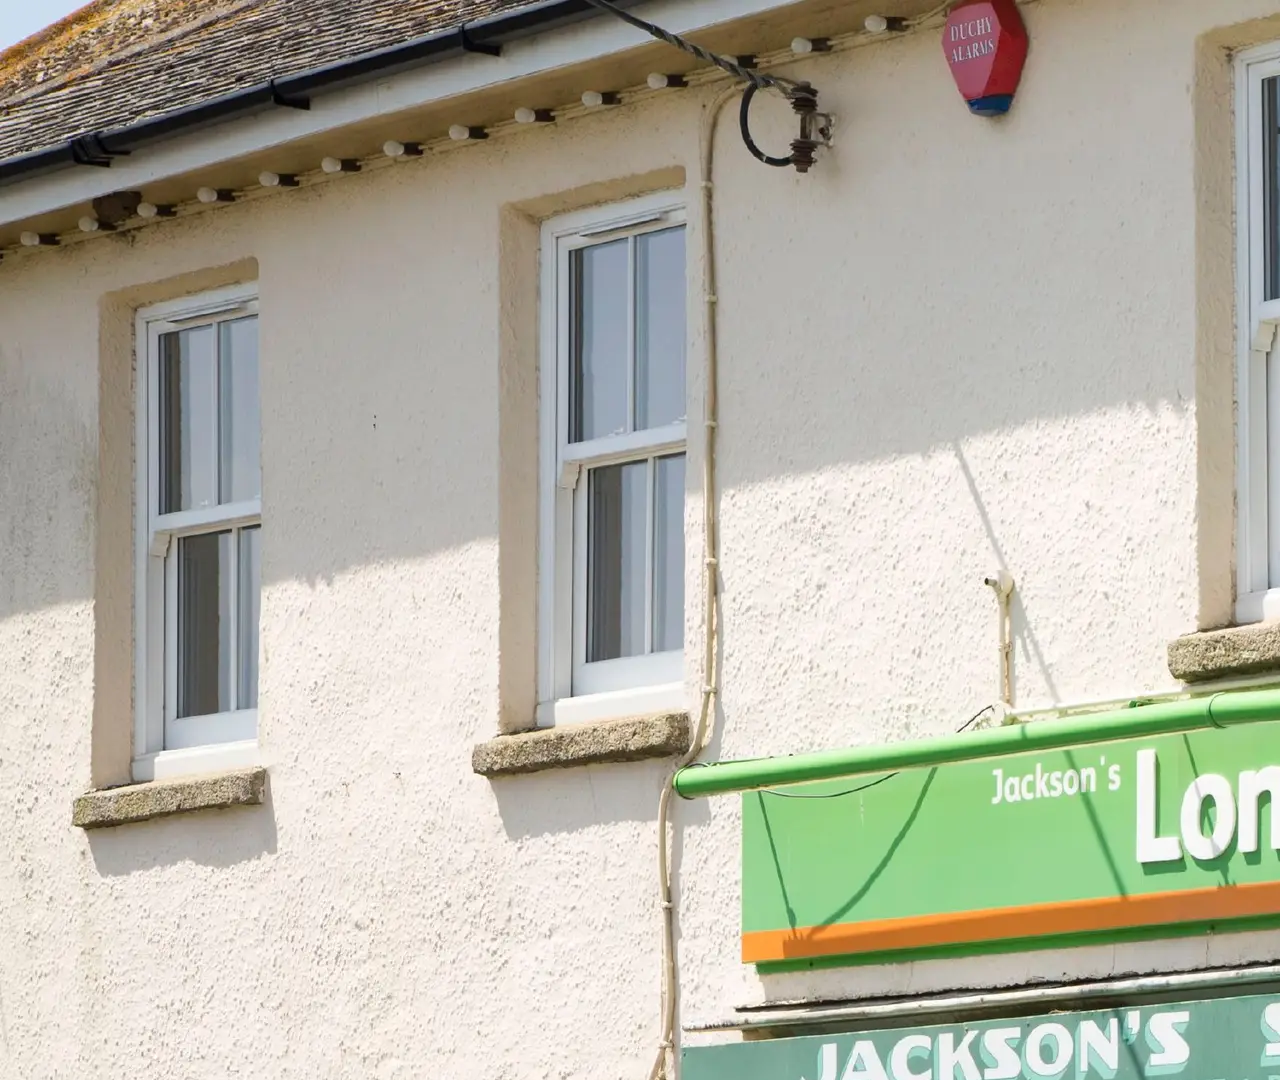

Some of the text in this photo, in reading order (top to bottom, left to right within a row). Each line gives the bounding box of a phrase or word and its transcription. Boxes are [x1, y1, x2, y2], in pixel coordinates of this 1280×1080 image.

[951, 16, 992, 41] DUCHY
[952, 39, 994, 63] ALARMS
[990, 756, 1121, 804] Jackson's
